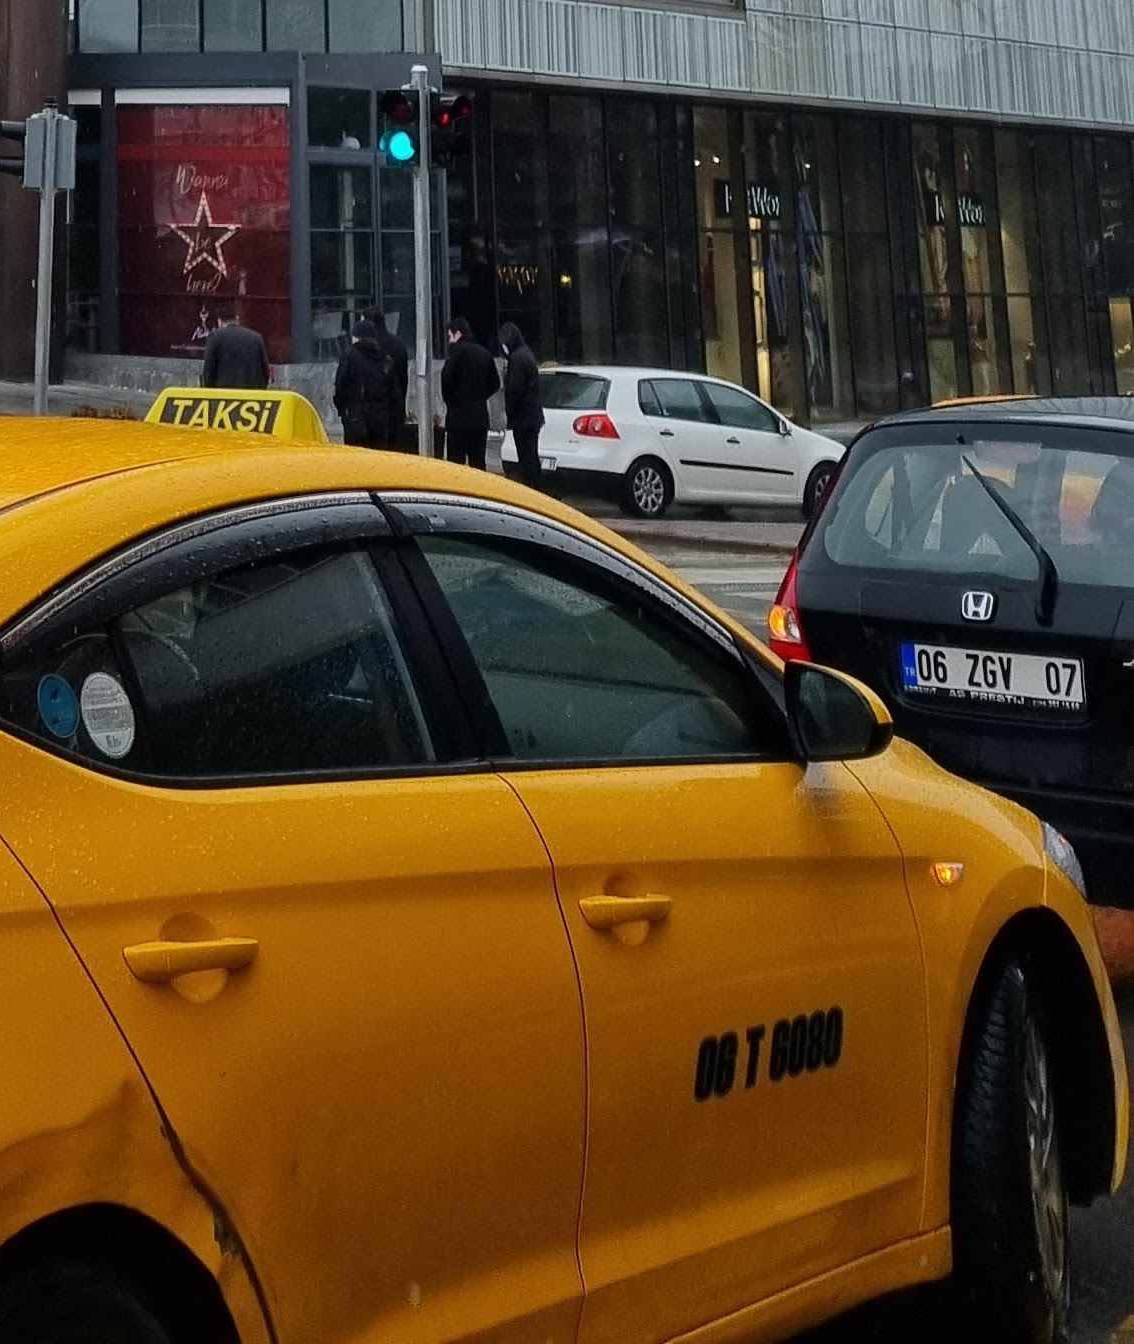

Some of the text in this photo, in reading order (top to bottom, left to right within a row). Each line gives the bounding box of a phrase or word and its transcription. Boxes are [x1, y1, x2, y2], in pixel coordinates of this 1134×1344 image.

[917, 649, 1077, 697] 06 ZGV 07
[695, 1006, 843, 1101] 06 T 6080
